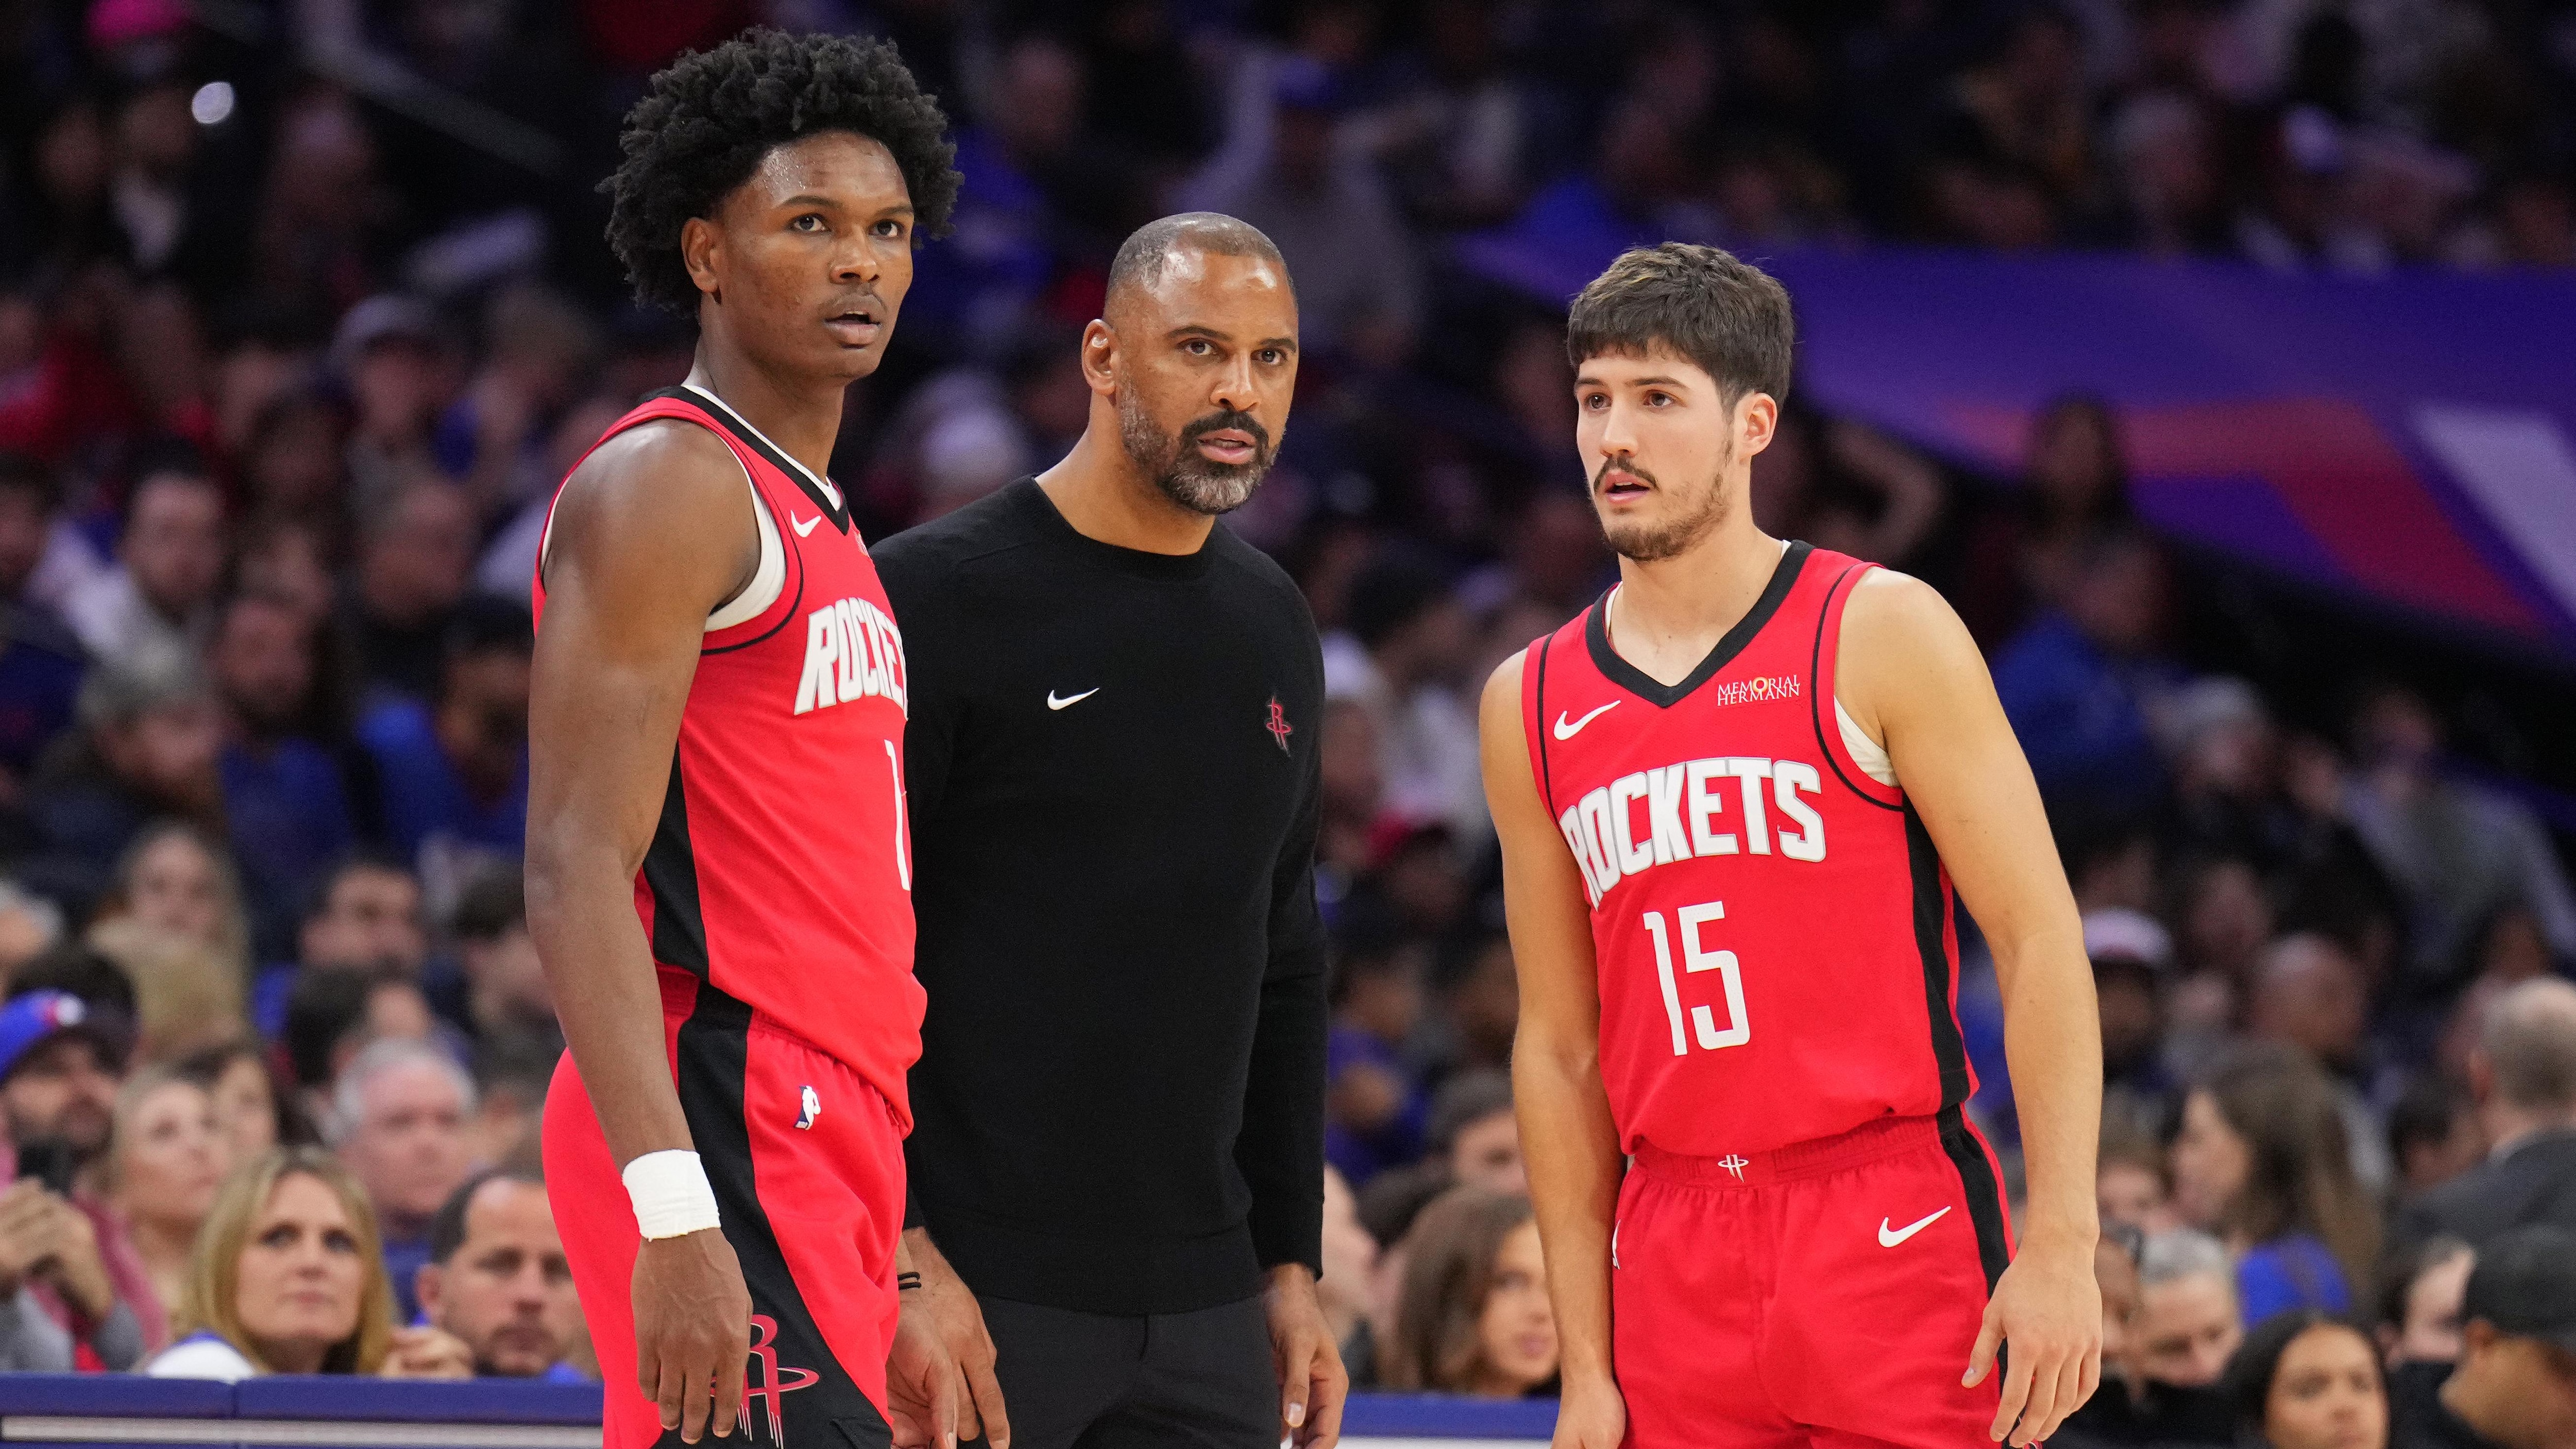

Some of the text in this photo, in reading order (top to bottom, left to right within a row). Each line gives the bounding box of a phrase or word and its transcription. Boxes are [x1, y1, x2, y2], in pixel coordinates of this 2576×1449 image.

[1717, 685, 1800, 706] HERMANN
[1718, 675, 1801, 696] MEMORIAL
[884, 739, 911, 890] 1
[1558, 756, 1826, 912] ROCKETS
[1642, 901, 1751, 1056] 15
